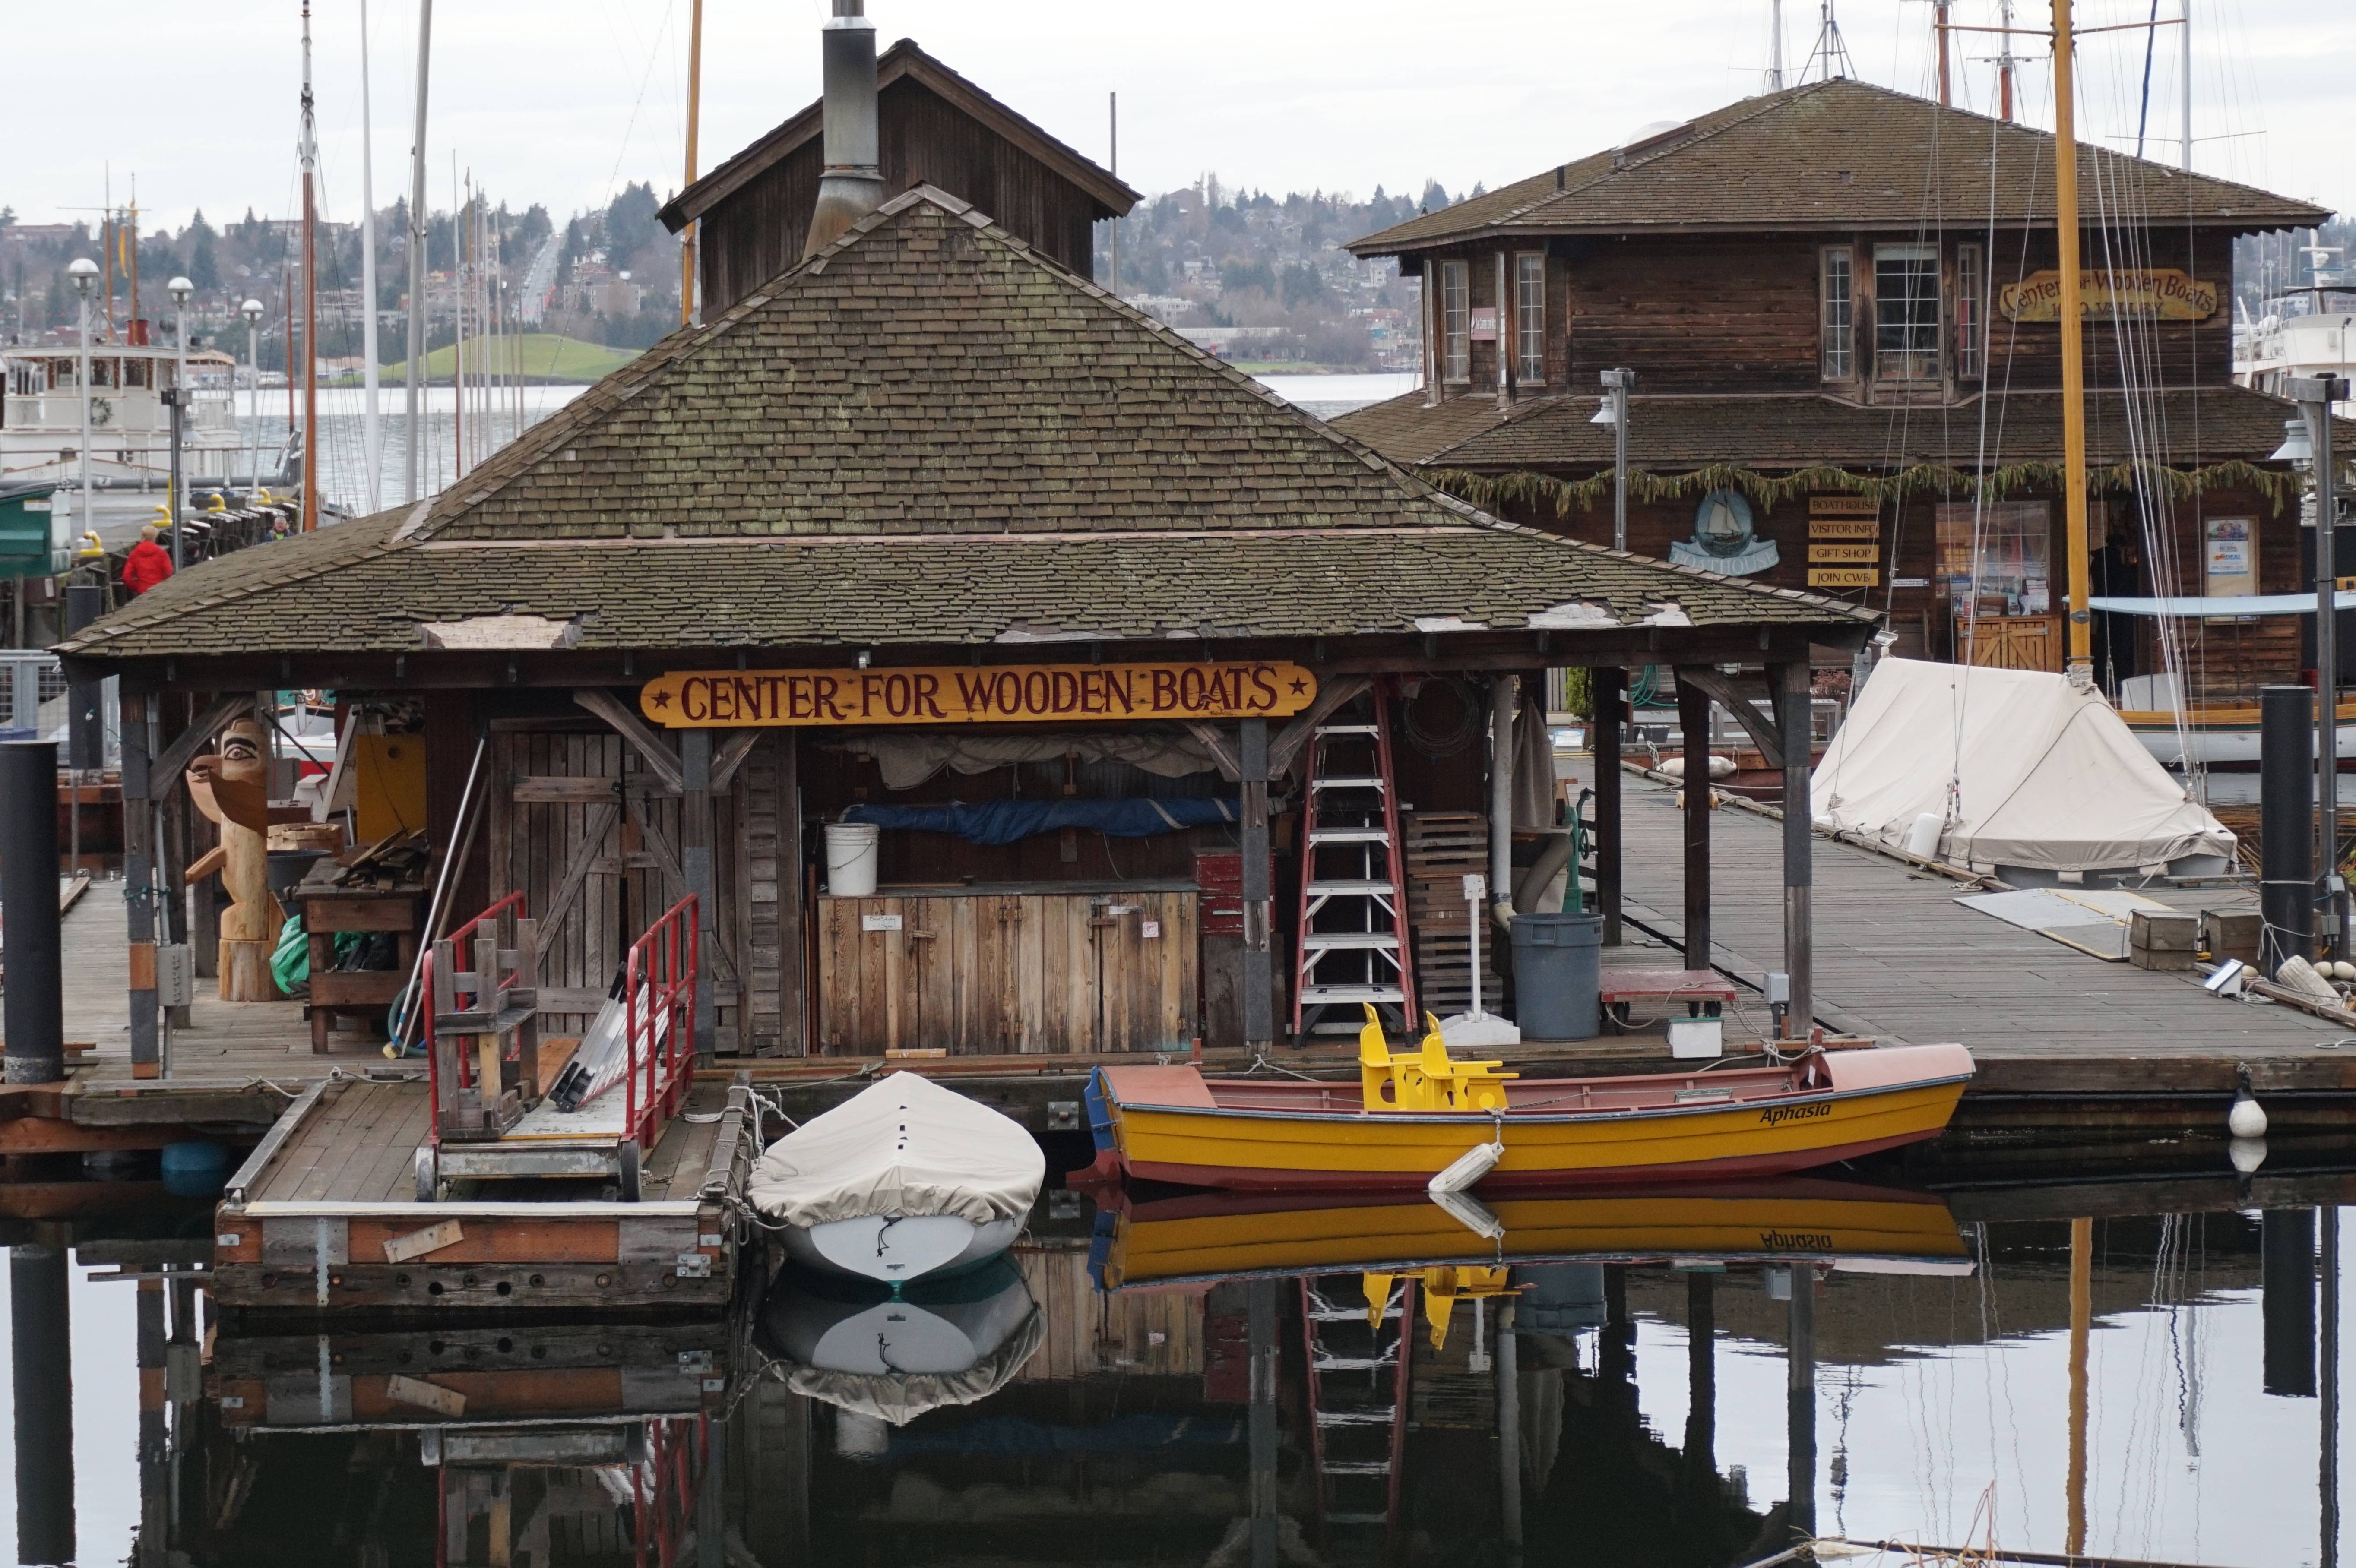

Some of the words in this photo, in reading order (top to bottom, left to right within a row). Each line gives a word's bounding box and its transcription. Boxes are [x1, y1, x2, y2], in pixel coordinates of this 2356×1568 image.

[2004, 281, 2061, 312] Center
[2094, 270, 2162, 299] Wooden
[2164, 273, 2214, 312] Boats
[2096, 302, 2165, 315] VALLEY
[1813, 501, 1877, 510] BOATHOUSE
[1811, 525, 1851, 534] VISITOR
[1854, 525, 1878, 534] INFO
[1816, 549, 1840, 558] GIFT
[1842, 549, 1871, 558] SHOP
[1817, 573, 1840, 585] JOIN
[1844, 573, 1870, 582] CWB
[681, 676, 847, 721] CENTER
[861, 674, 947, 718] FOR
[955, 669, 1134, 715] WOODEN
[1151, 666, 1278, 713] BOATS
[1759, 1103, 1831, 1126] Aphasia
